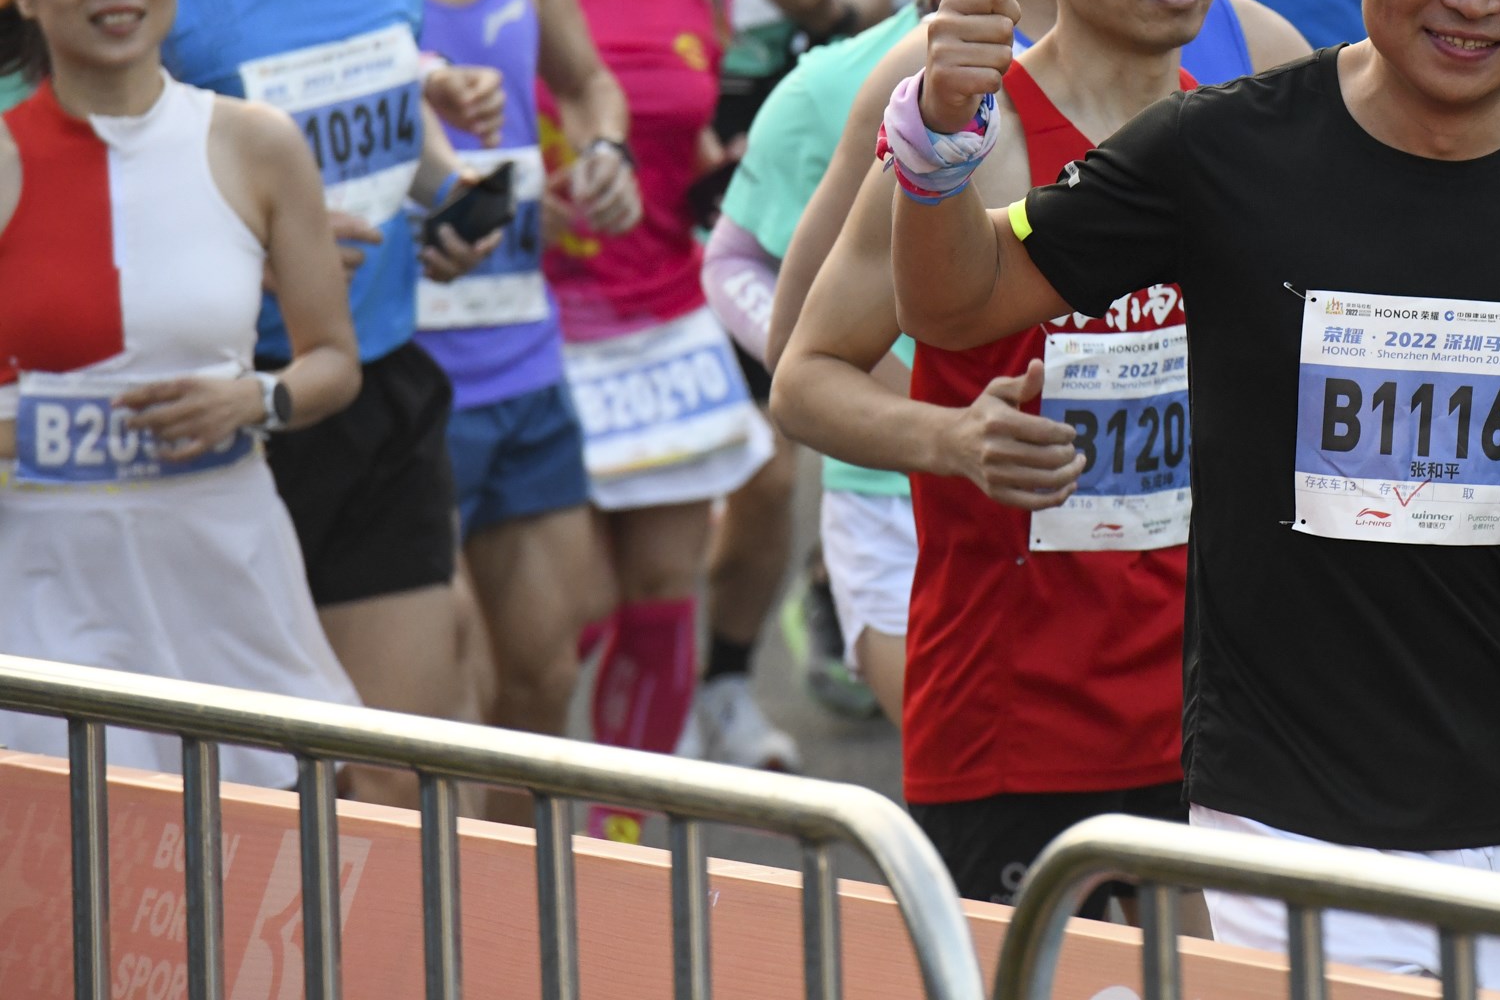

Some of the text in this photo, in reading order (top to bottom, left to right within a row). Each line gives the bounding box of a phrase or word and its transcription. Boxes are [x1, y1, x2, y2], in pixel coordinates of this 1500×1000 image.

[1375, 308, 1418, 320] HONOR
[1323, 326, 1364, 345] 荣耀
[1384, 331, 1437, 350] 2022
[1321, 345, 1366, 358] HONOR
[1377, 349, 1430, 362] Shenzhen
[1431, 351, 1483, 365] Marathon
[1118, 362, 1158, 379] 2022
[1065, 402, 1190, 474] B120
[1410, 461, 1460, 480] 张和平
[1304, 475, 1357, 492] 存衣车13
[1379, 482, 1392, 496] 存
[1463, 488, 1475, 500] 取
[1355, 519, 1392, 528] LI-NING
[1411, 511, 1454, 522] winner
